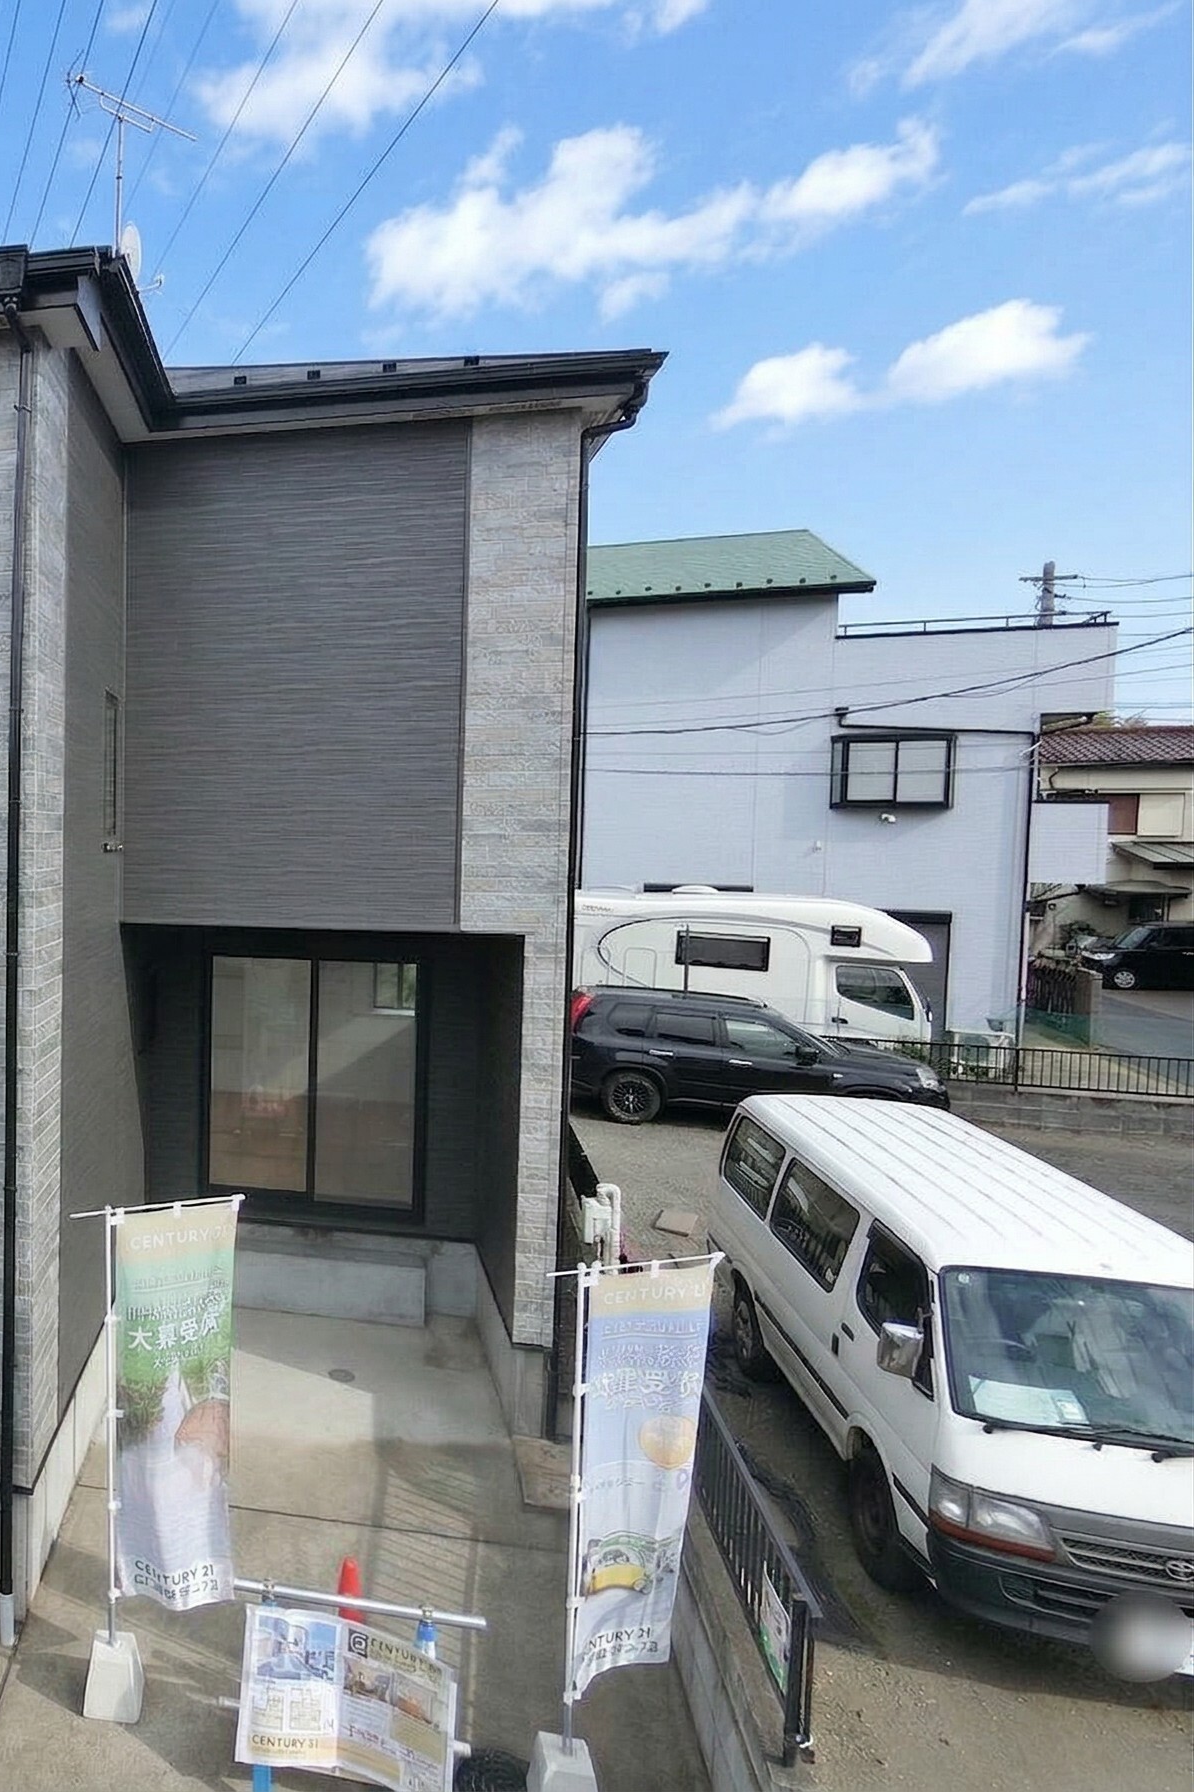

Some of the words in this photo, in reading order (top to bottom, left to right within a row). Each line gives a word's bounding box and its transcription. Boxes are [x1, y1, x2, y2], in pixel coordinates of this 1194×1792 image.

[130, 1229, 209, 1250] CENTURY
[604, 1286, 686, 1305] CENTURY
[135, 1560, 197, 1586] CENTURY
[202, 1564, 214, 1577] 21
[252, 1734, 306, 1749] CENTURY
